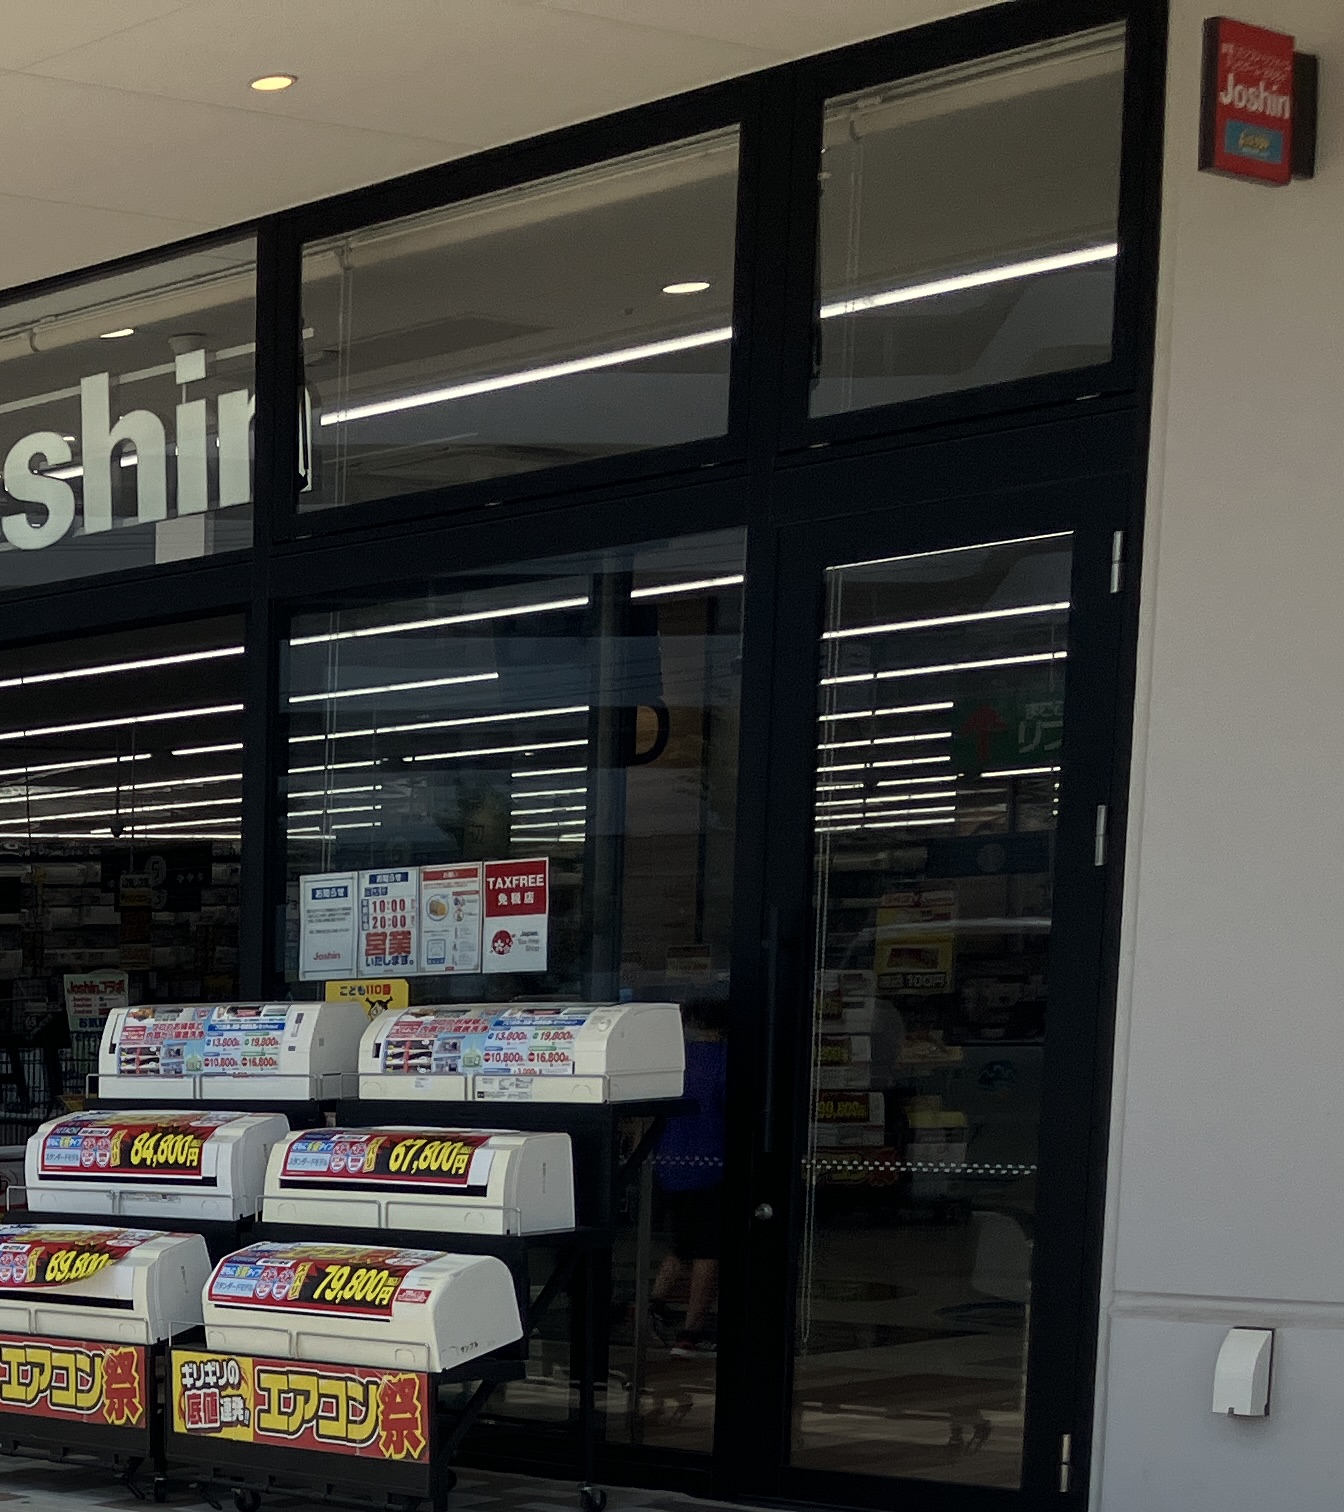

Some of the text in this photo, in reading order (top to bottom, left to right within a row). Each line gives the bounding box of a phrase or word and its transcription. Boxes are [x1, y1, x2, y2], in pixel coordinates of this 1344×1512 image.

[1219, 72, 1291, 119] Joshin
[487, 874, 545, 890] TAXFREE
[372, 898, 406, 914] 10:00
[497, 891, 535, 906] 免税店
[372, 915, 406, 929] 20:00
[181, 1358, 240, 1388] ギリギリの
